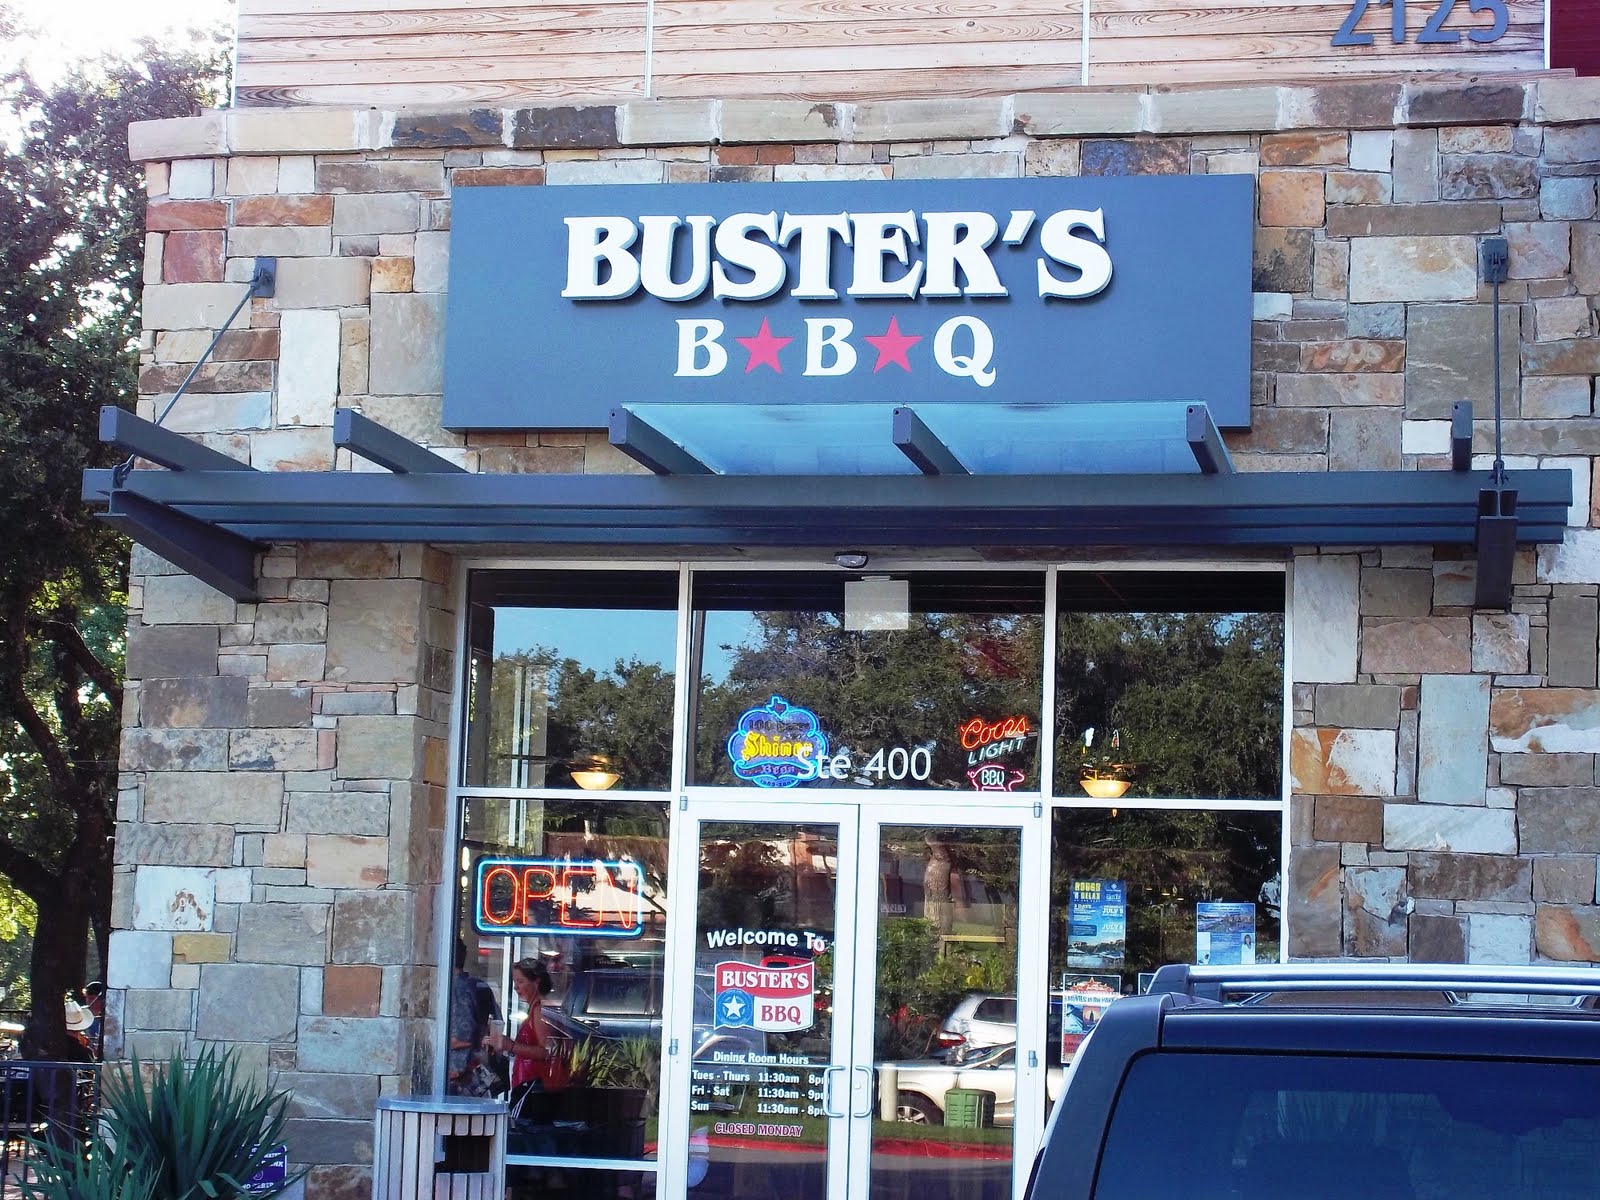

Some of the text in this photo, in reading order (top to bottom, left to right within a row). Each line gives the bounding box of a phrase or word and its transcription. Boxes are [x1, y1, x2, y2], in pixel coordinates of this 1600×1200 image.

[1330, 0, 1509, 46] 2125
[560, 207, 1113, 302] BUSTER'S
[960, 716, 1030, 749] Coors
[741, 730, 813, 761] Shiner
[968, 736, 1027, 765] LIGHT
[797, 746, 932, 781] Ste 400
[981, 769, 1005, 788] BBQ
[484, 867, 636, 929] OPEN
[706, 927, 825, 952] Welcome To
[721, 970, 810, 989] BUSTER'S
[761, 1005, 802, 1025] BBQ
[713, 1050, 809, 1065] Dining Room Hours
[692, 1069, 714, 1080] Tues
[723, 1070, 750, 1081] Thurs
[758, 1072, 799, 1083] 11:30am
[691, 1085, 704, 1095] Fri
[713, 1086, 730, 1096] Sat
[757, 1087, 799, 1099] 11:30am
[690, 1101, 709, 1111] Sun
[757, 1103, 798, 1115] 11:30am
[714, 1122, 803, 1137] CLOSED MONDAY
